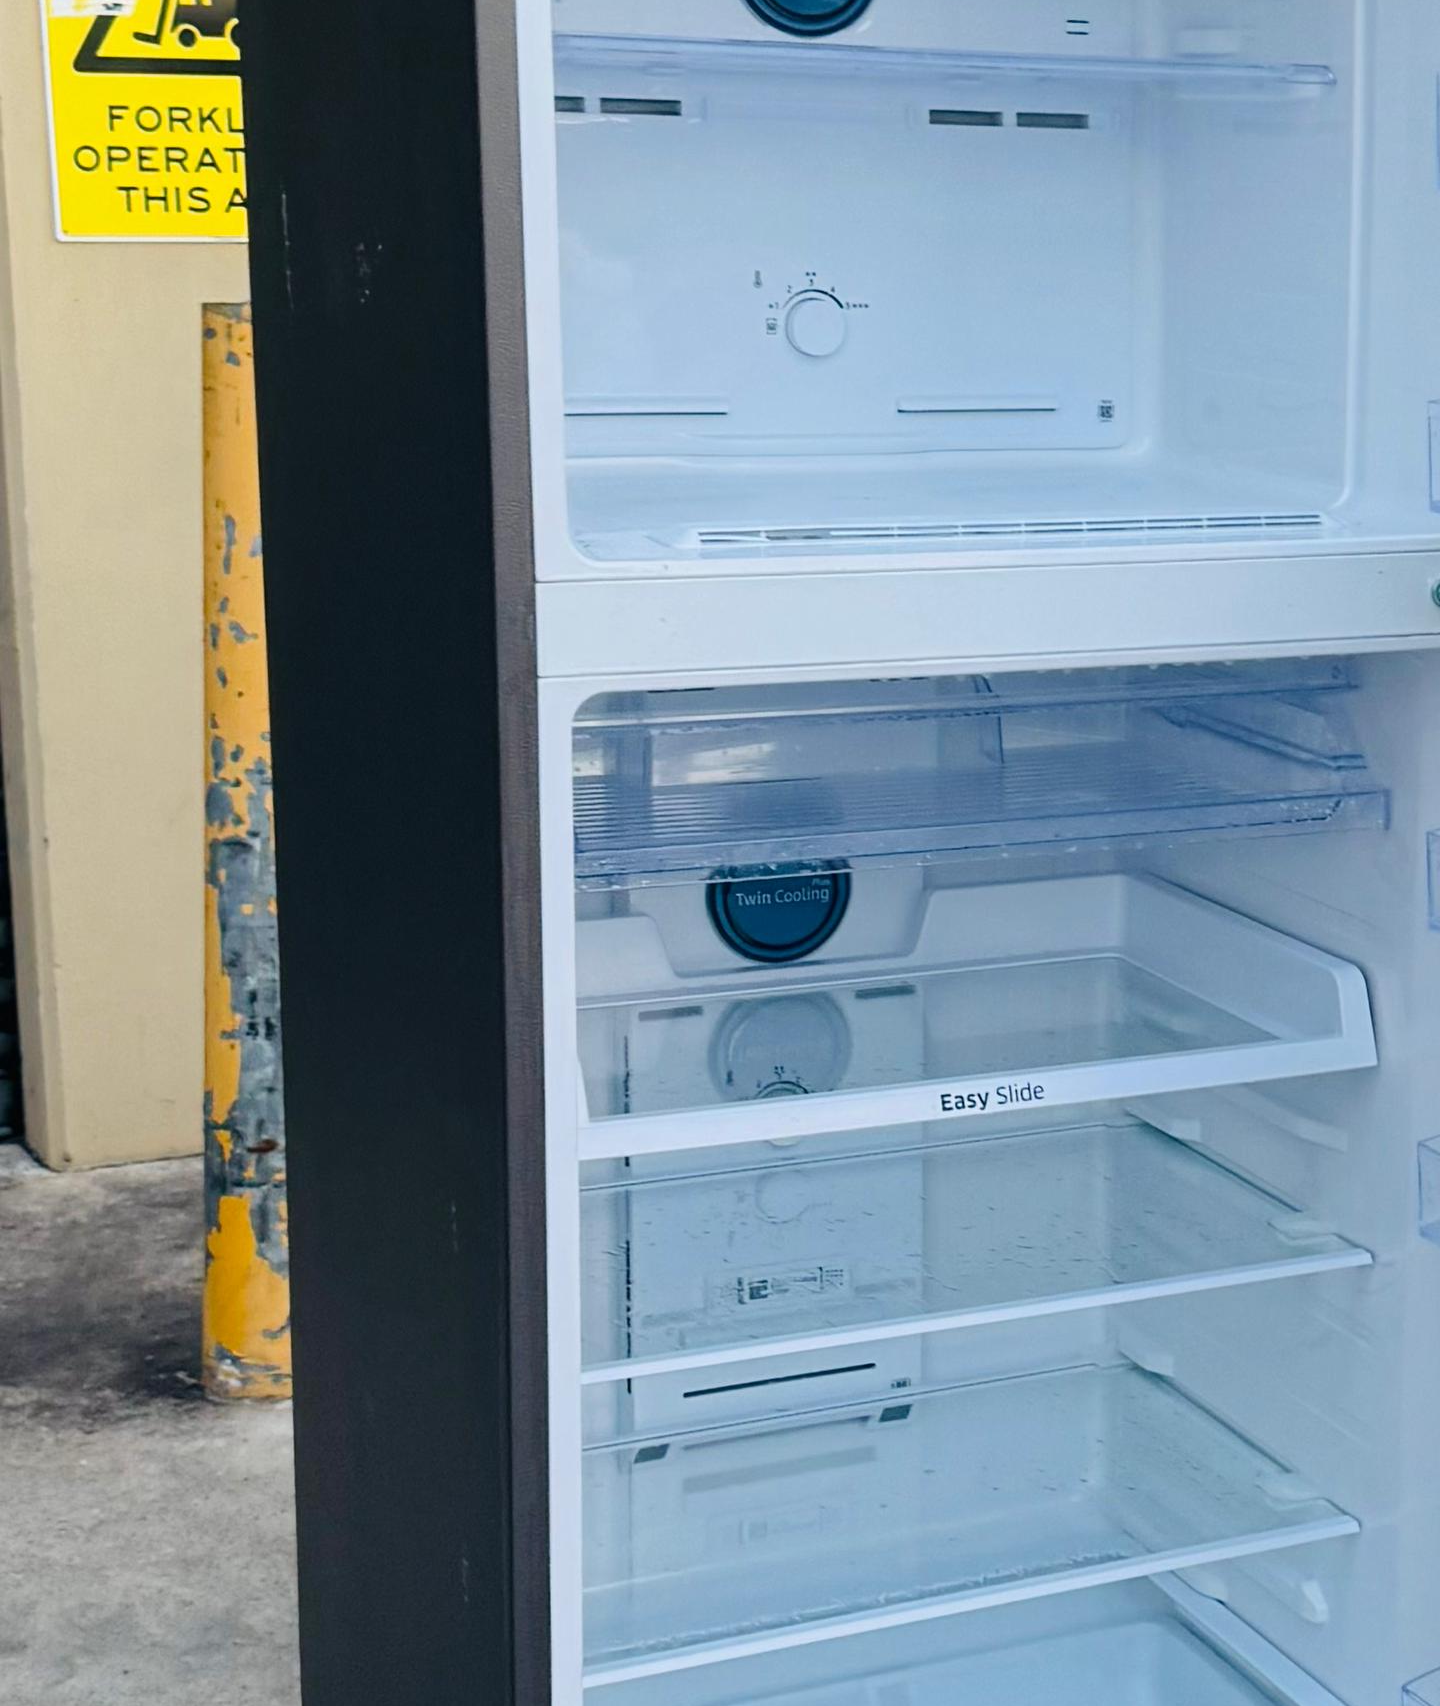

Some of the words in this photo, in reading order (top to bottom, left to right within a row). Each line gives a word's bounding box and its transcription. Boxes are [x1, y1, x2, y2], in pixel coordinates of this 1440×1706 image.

[73, 145, 246, 174] OPERAT
[116, 186, 212, 213] THIS
[736, 891, 771, 906] Twin
[775, 886, 830, 903] Cooling
[940, 1092, 990, 1111] Easy
[996, 1082, 1045, 1105] Slide
